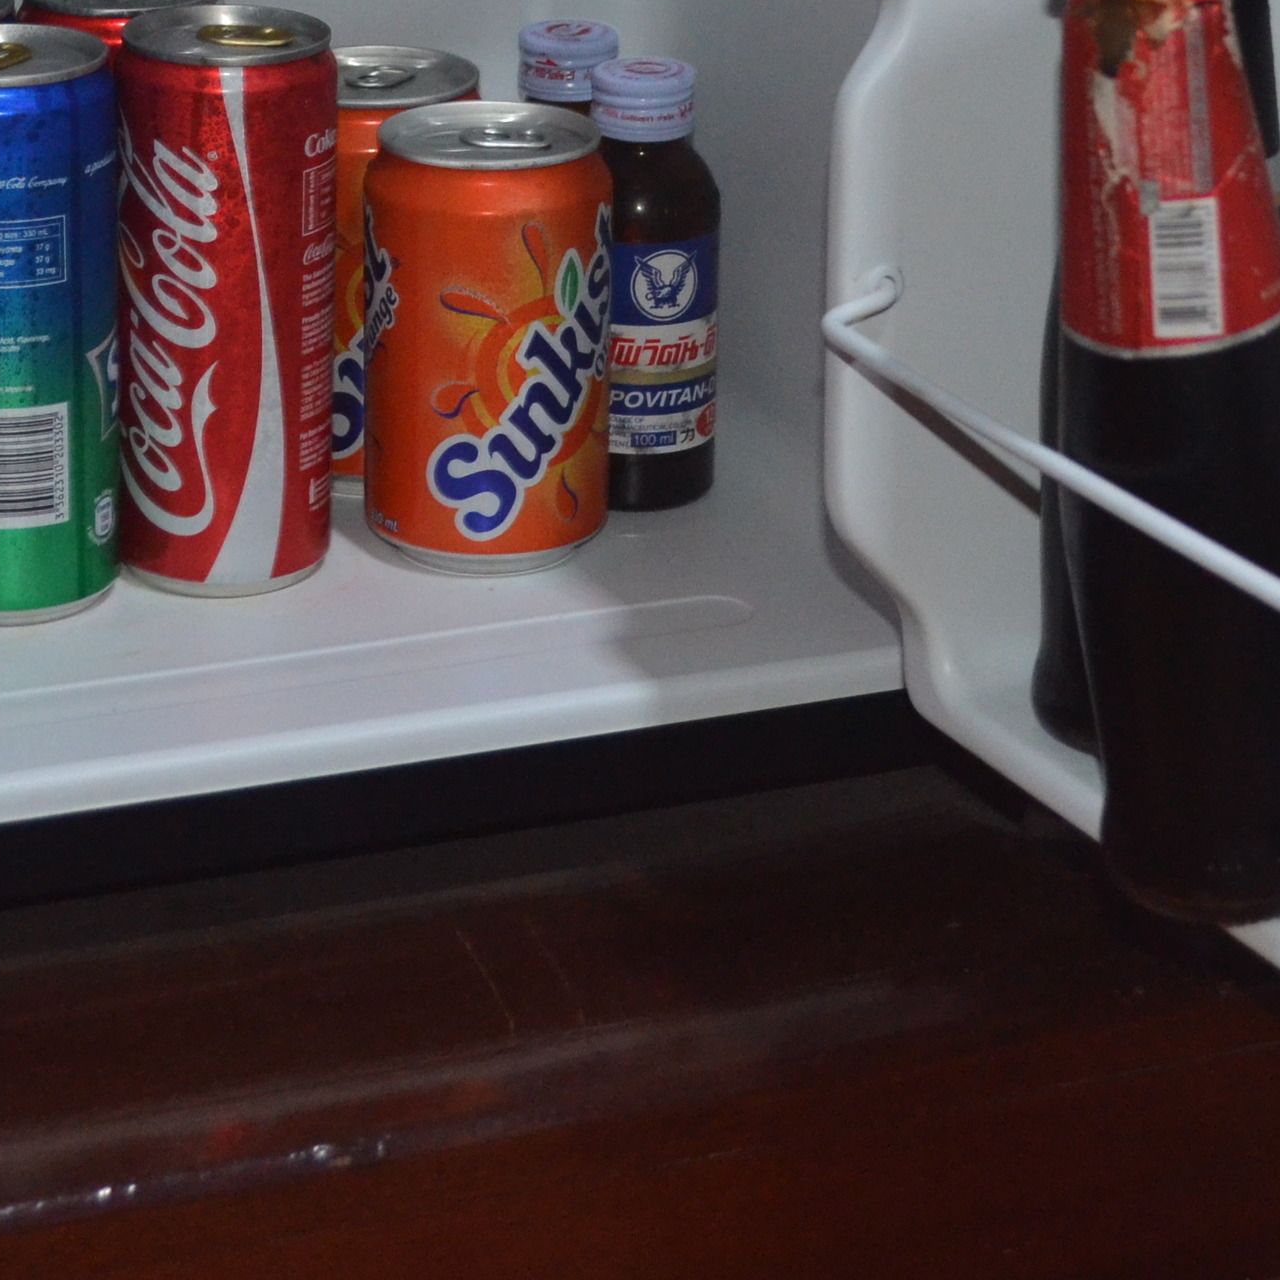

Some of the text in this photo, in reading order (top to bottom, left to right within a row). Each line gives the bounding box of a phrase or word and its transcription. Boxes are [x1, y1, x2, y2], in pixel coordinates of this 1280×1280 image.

[28, 176, 68, 190] Company
[117, 123, 221, 536] Coca-Cola
[54, 414, 65, 520] 203302 362310 3
[634, 433, 675, 446] 100 ml
